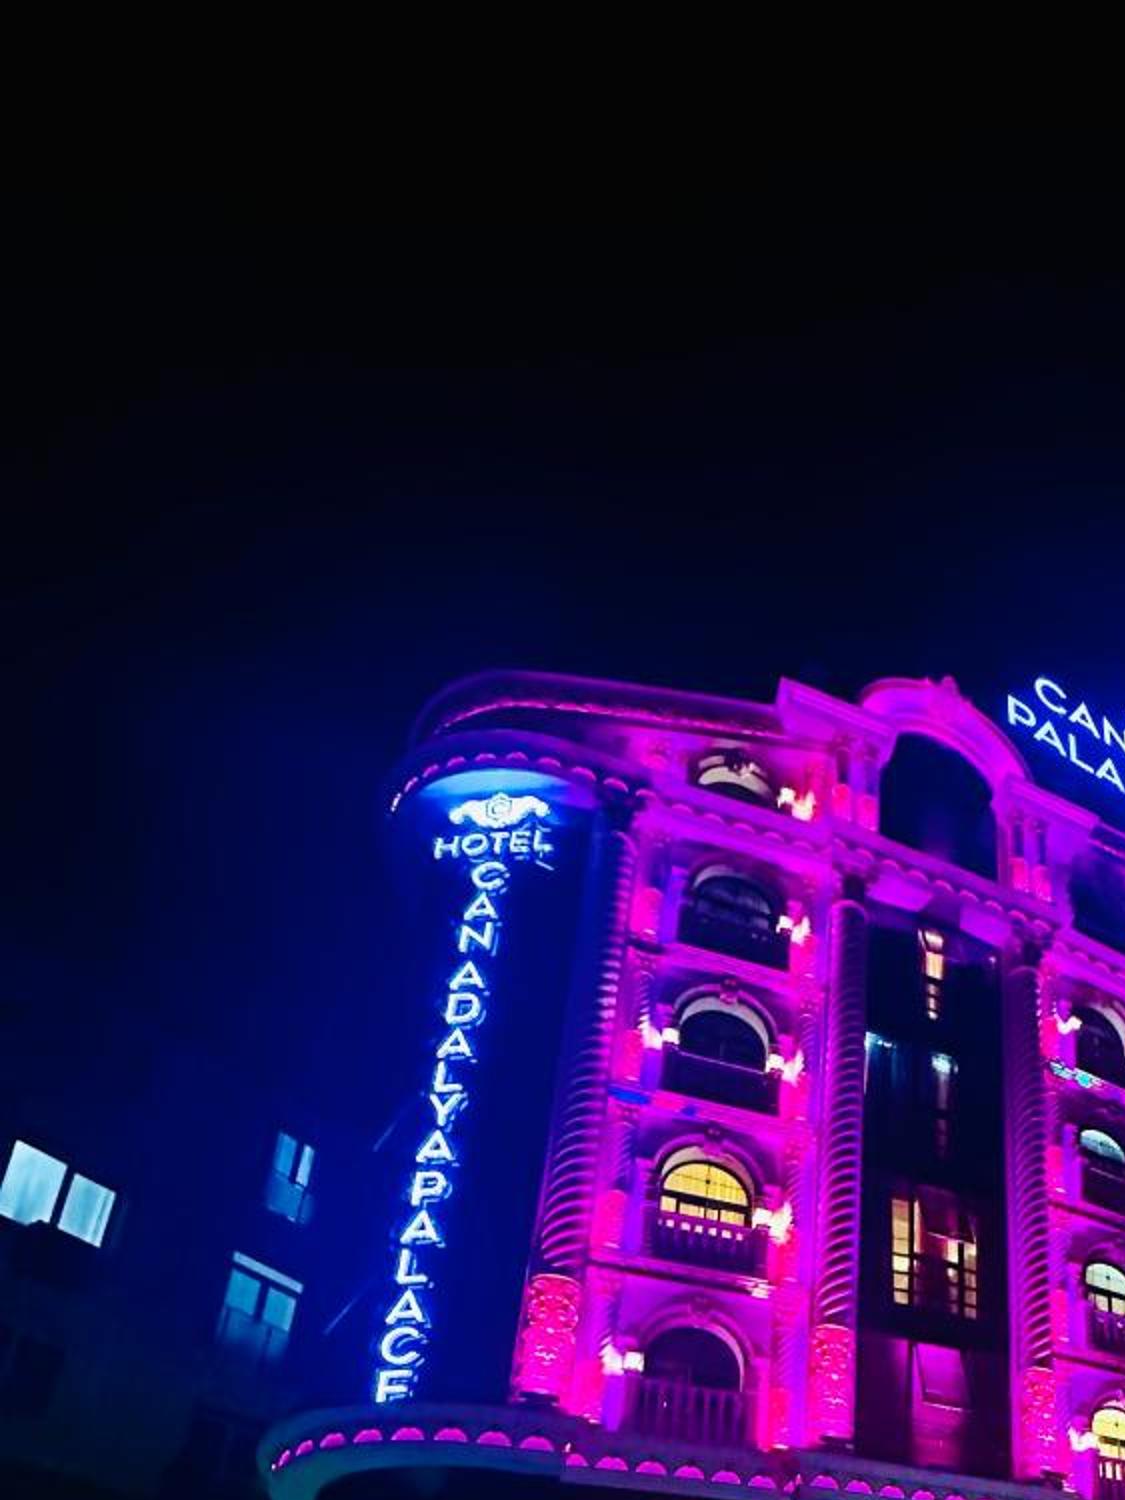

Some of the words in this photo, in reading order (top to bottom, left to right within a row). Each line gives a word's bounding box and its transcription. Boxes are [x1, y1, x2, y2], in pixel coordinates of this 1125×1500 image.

[433, 829, 554, 860] HOTEL
[457, 861, 511, 953] CAN
[415, 960, 486, 1163] ADALYA
